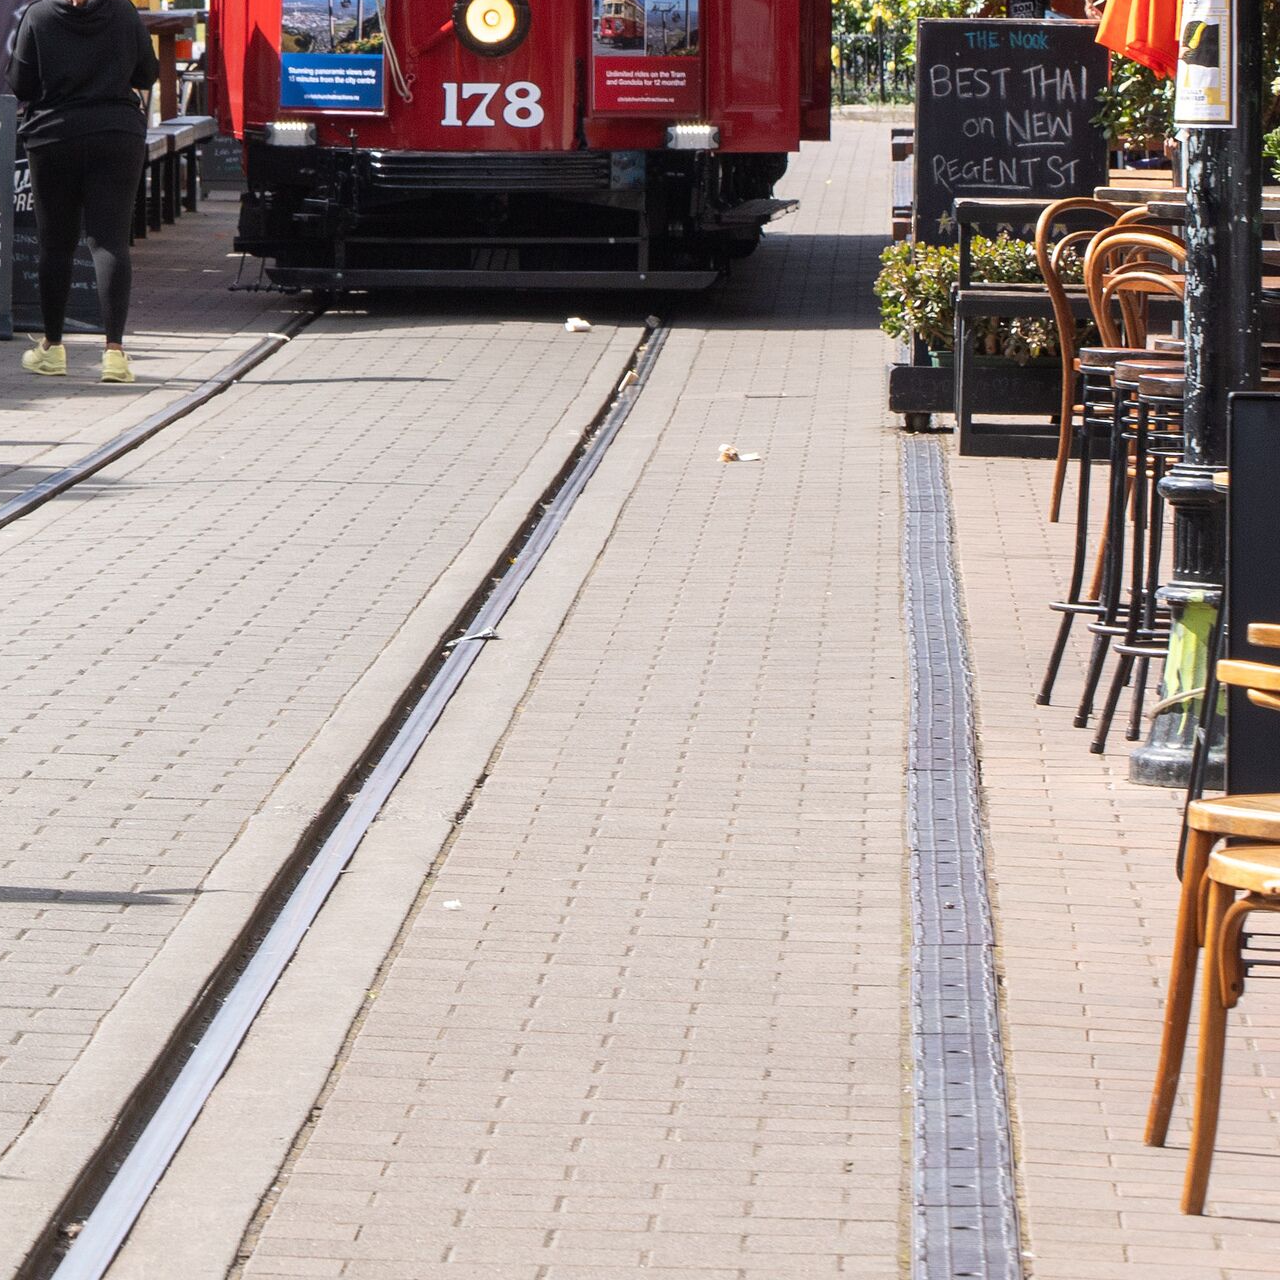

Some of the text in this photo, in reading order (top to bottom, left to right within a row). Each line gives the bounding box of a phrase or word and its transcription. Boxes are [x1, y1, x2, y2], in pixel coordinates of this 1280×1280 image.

[965, 32, 1000, 49] THE
[930, 64, 1088, 103] BEST THAI
[440, 81, 545, 128] 178
[962, 109, 1072, 144] on NEW
[932, 154, 1080, 193] REGENT ST
